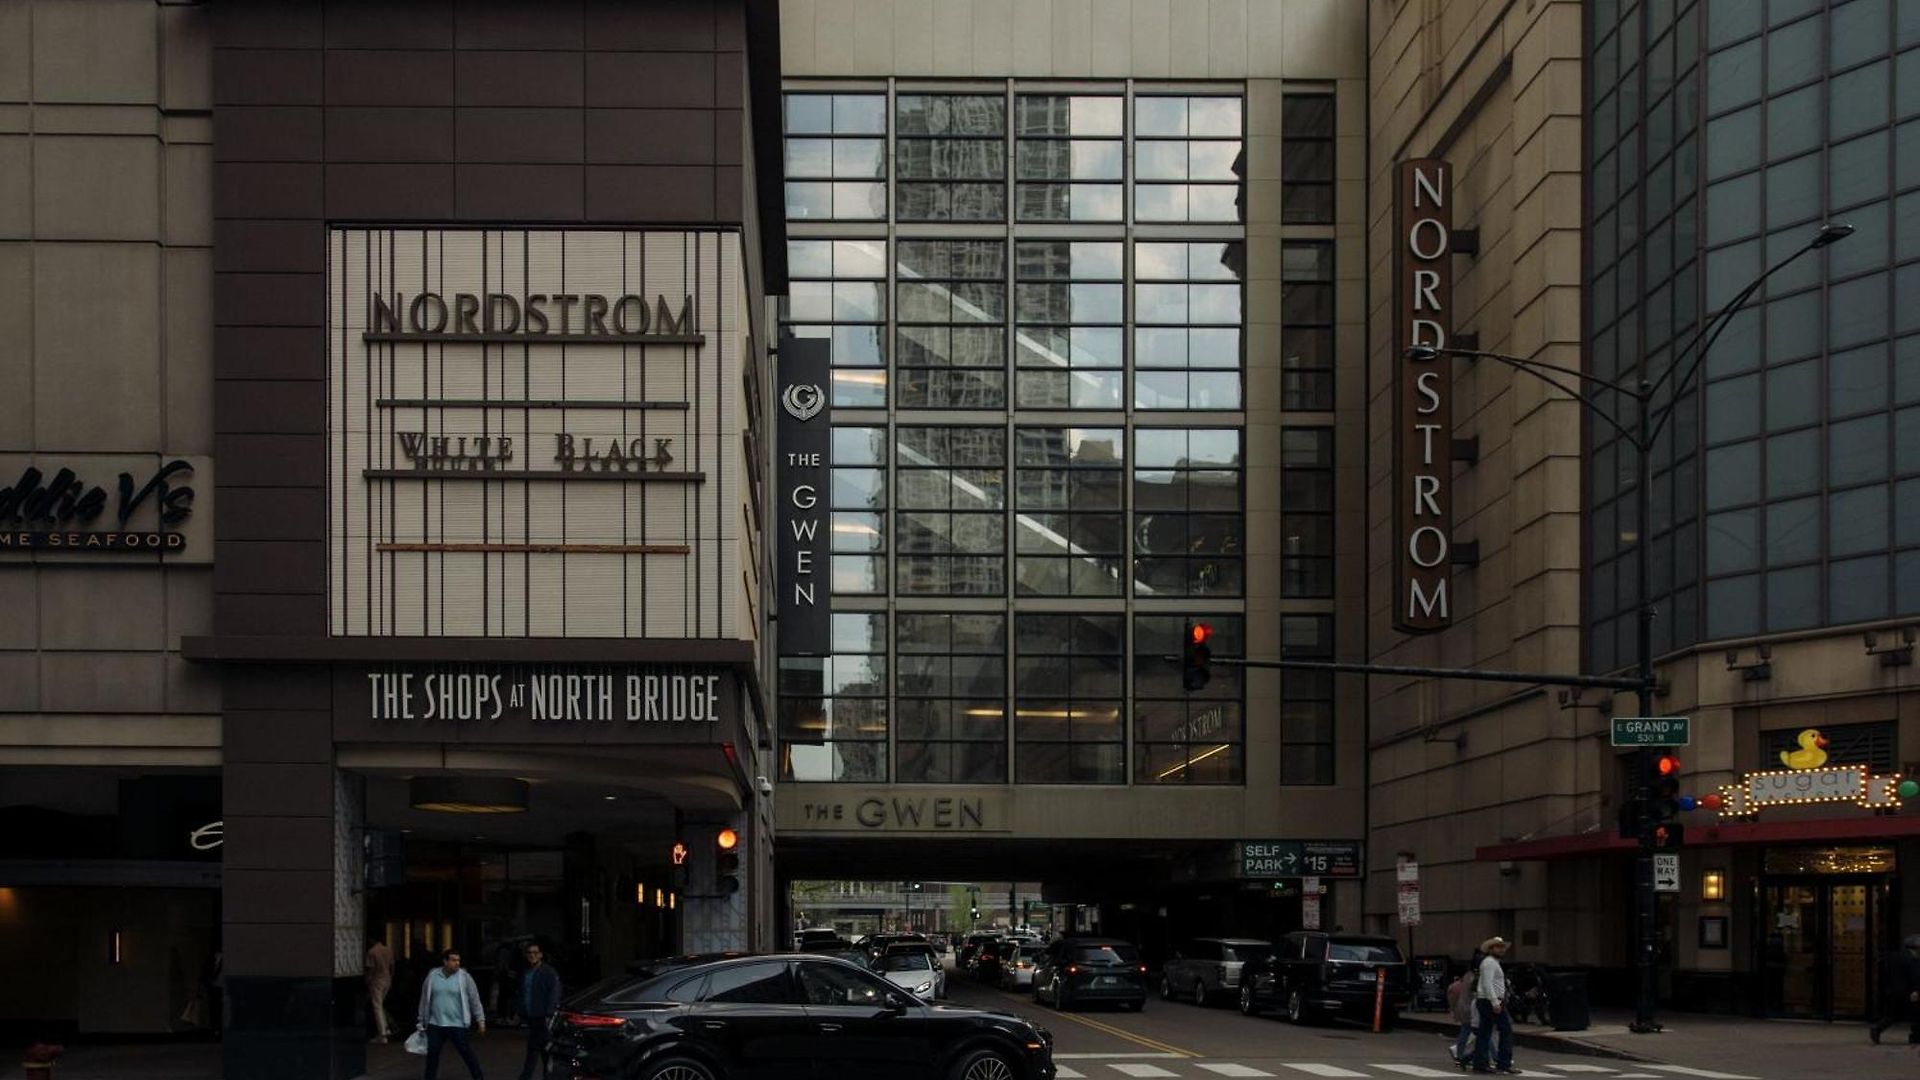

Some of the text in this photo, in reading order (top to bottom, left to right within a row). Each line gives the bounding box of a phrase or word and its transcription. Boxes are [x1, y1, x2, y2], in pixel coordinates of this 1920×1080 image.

[373, 292, 695, 336] NORDSTROM
[1408, 167, 1448, 619] NORDSTROM
[397, 432, 513, 461] WHITE
[554, 433, 674, 463] BLACK
[788, 453, 820, 467] THE
[50, 533, 182, 547] SEAFOOD
[790, 485, 819, 606] GWEN
[368, 673, 720, 722] THE SHOPS AT NORTH BRIDGE
[1626, 721, 1670, 733] GRAND
[1673, 722, 1684, 731] AV
[1755, 771, 1856, 791] sugar
[804, 798, 984, 828] THE GWEN
[1245, 845, 1280, 857] SELF
[1245, 859, 1283, 871] PARK
[1657, 857, 1676, 866] ONE
[1657, 867, 1676, 875] WAY
